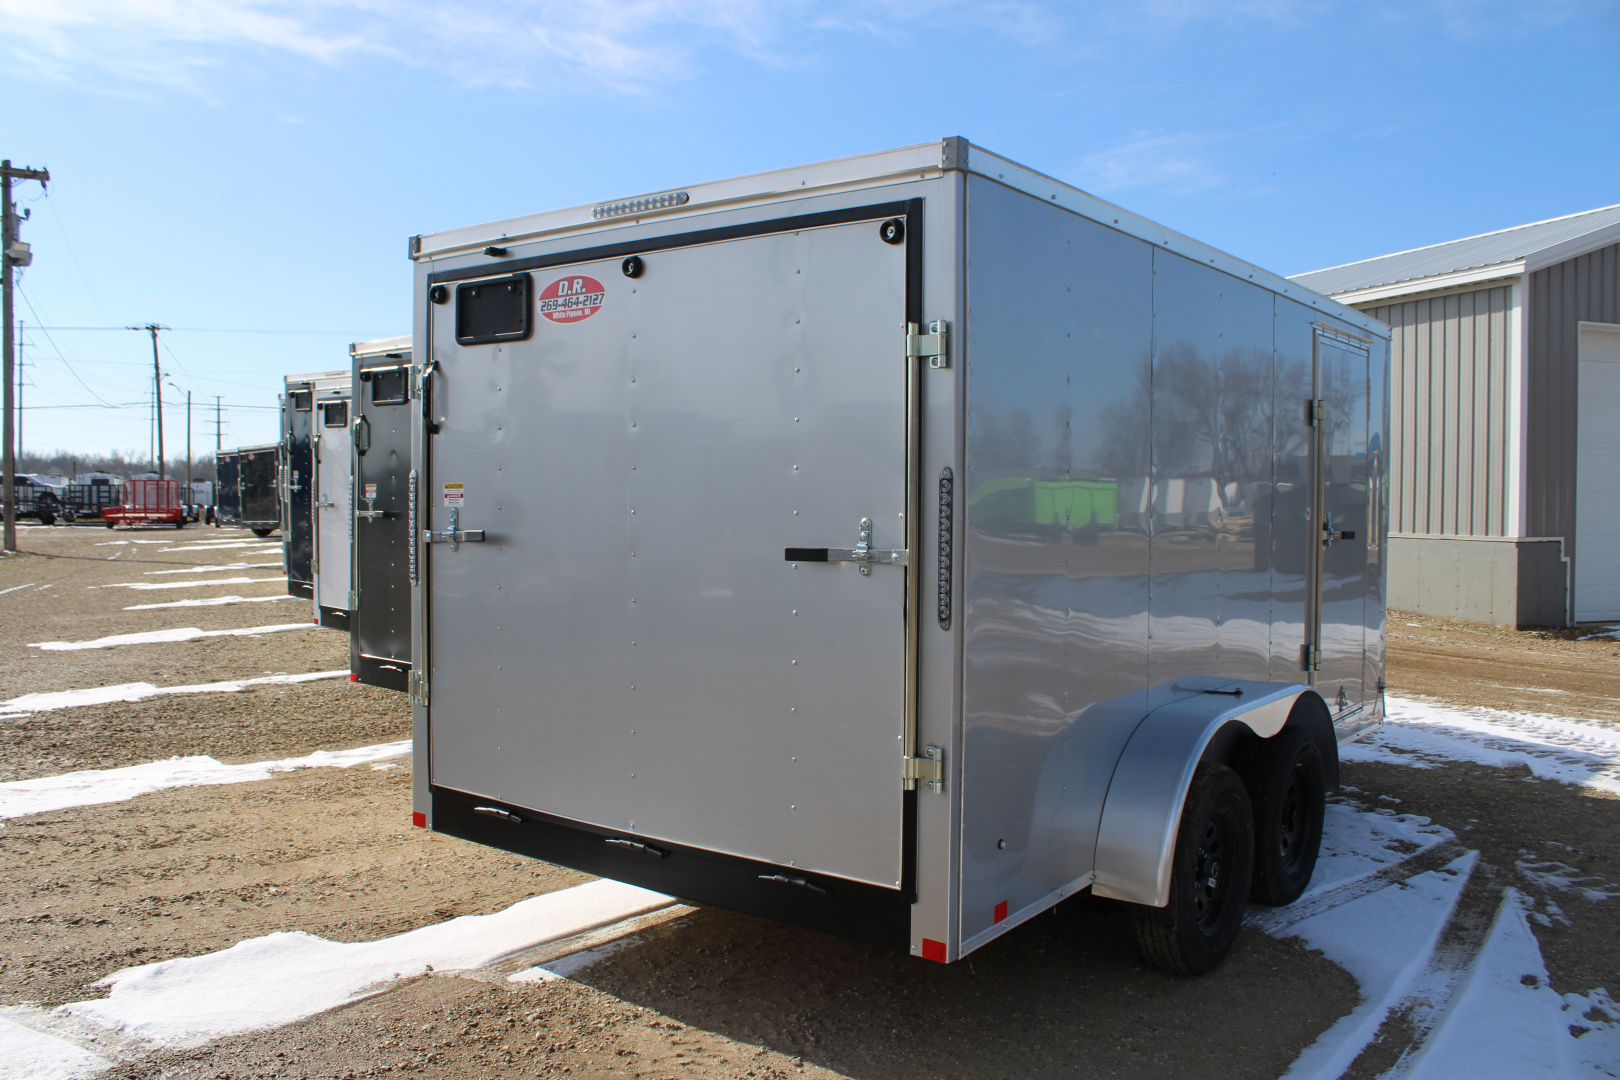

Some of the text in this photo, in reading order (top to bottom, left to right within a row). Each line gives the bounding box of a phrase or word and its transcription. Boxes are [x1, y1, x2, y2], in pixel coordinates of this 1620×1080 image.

[557, 278, 586, 296] D.R.
[541, 292, 605, 312] 269-464-2127
[552, 311, 566, 319] White
[584, 307, 591, 316] MI
